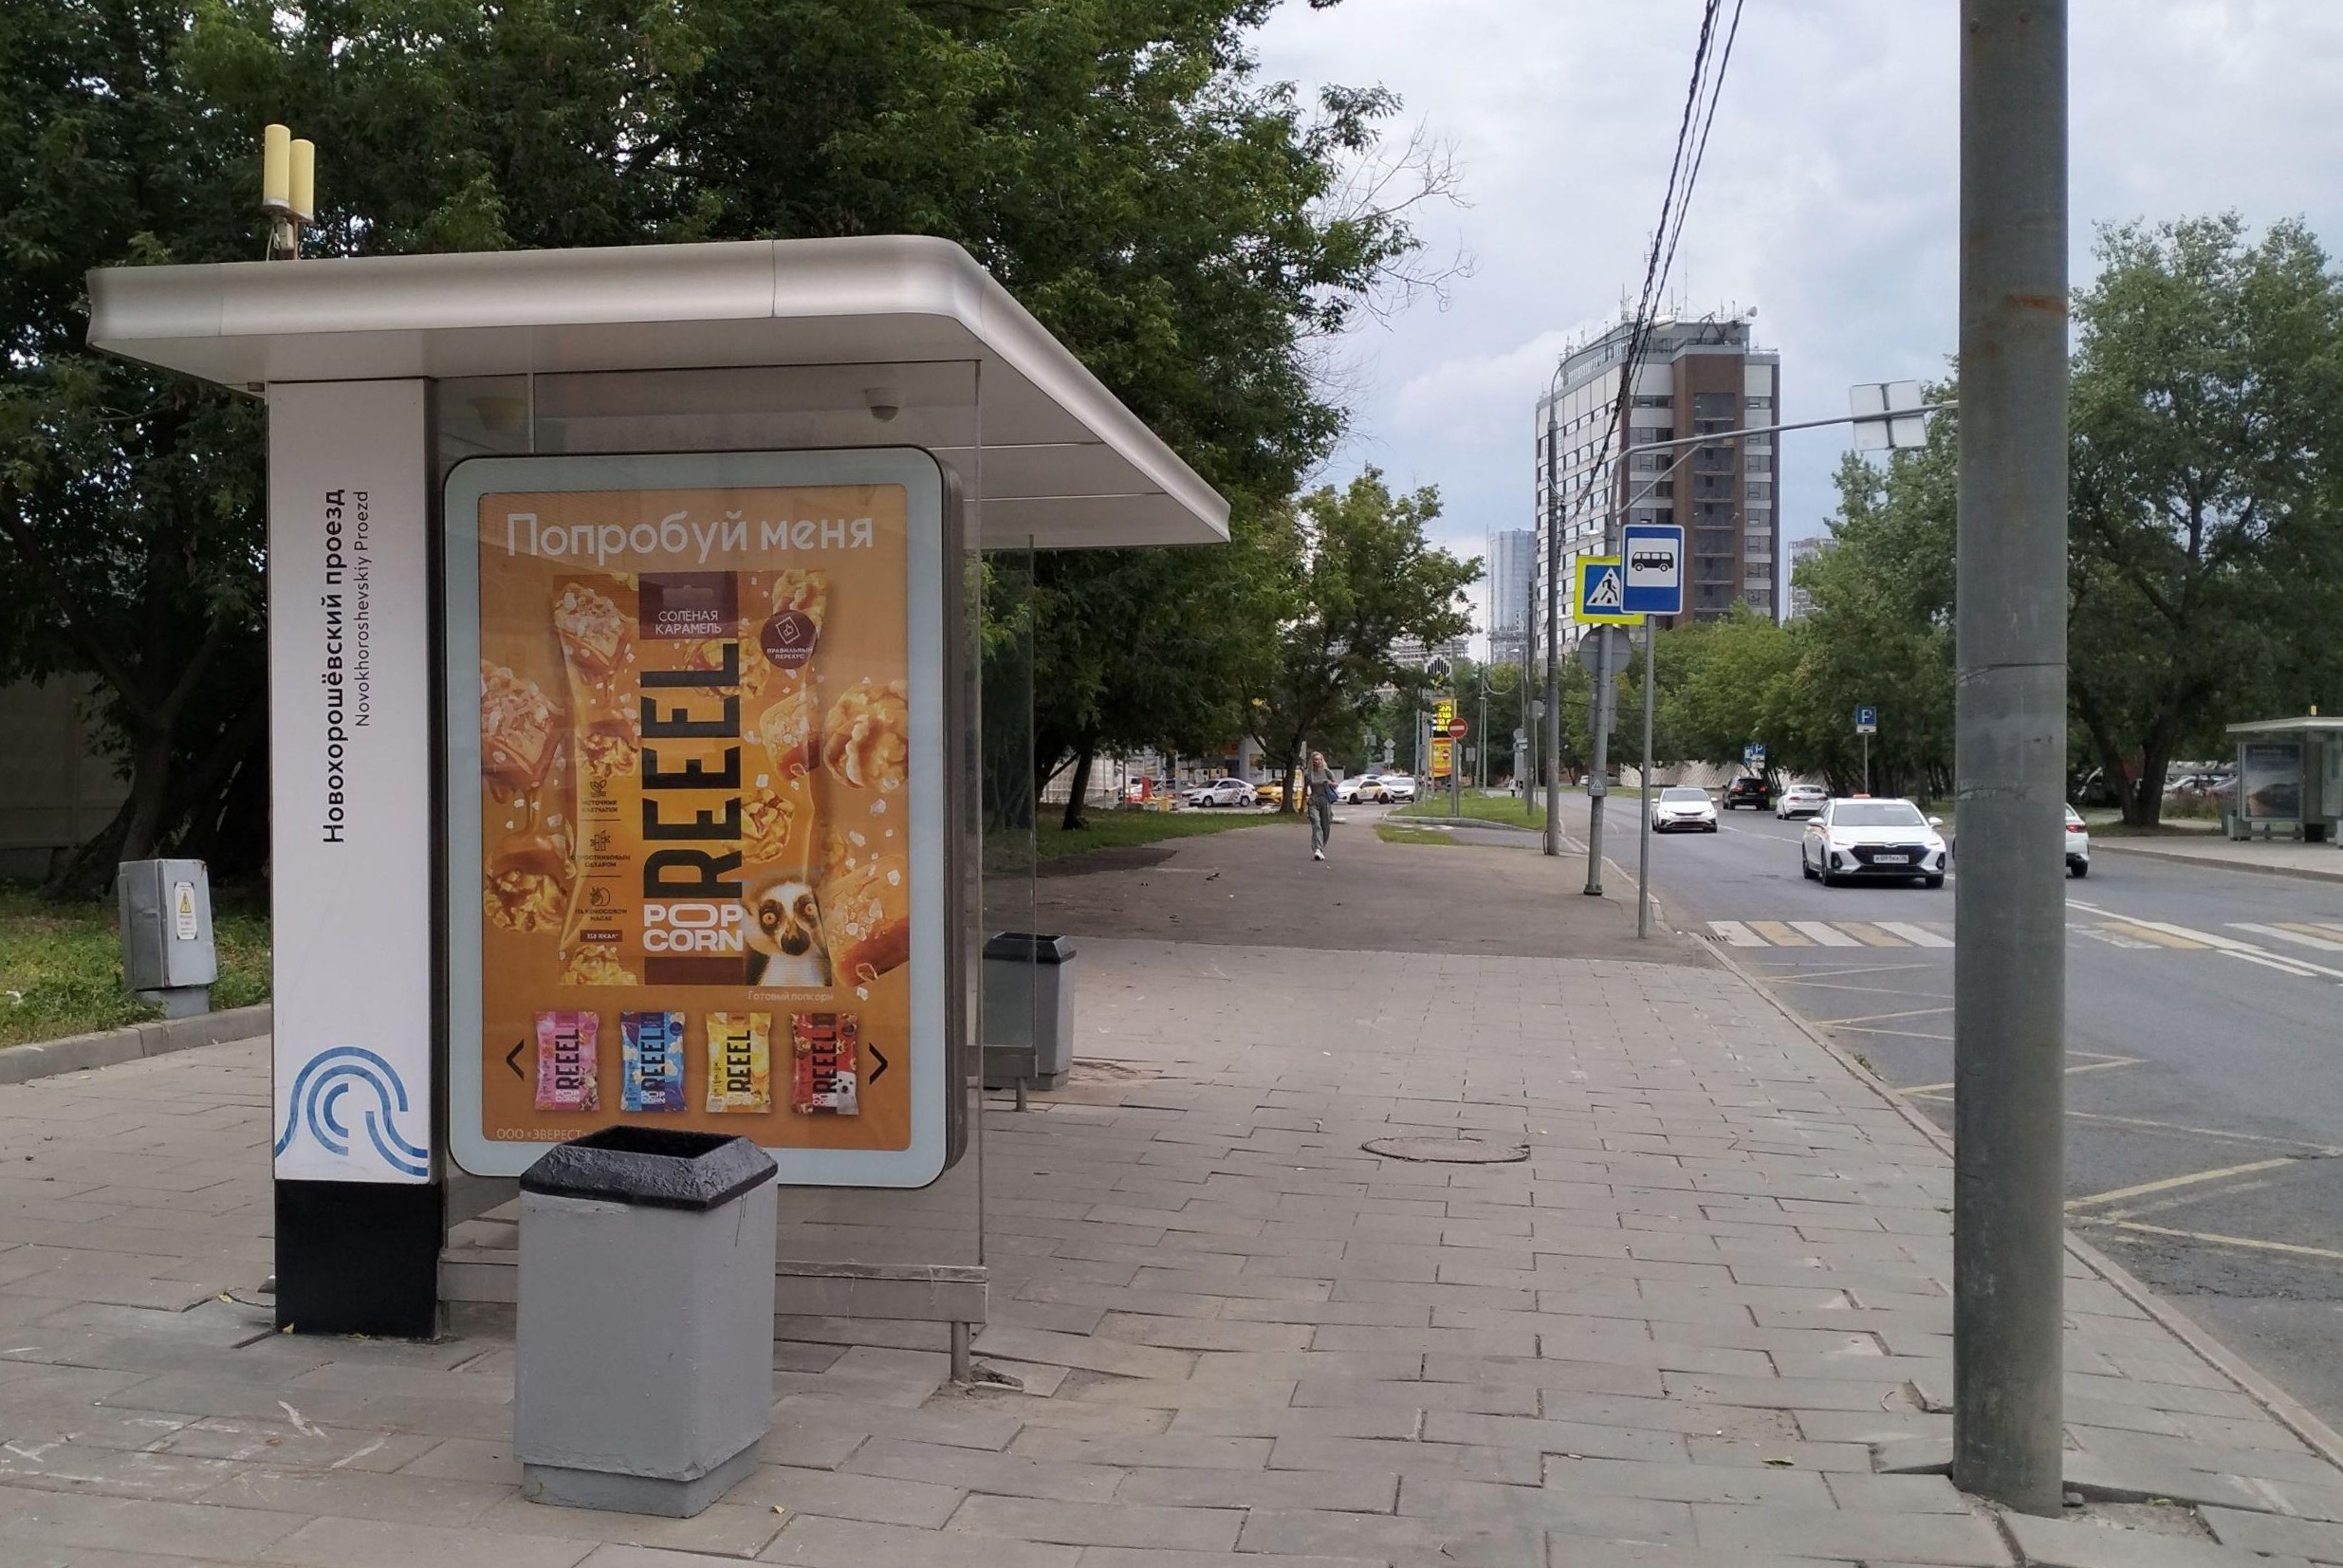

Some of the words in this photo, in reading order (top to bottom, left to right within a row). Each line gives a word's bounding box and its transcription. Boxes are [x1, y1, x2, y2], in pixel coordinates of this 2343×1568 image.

[326, 489, 347, 584] проезд
[353, 491, 369, 550] Proezd
[507, 509, 748, 566] Попробуй
[761, 517, 875, 551] меня
[655, 623, 723, 635] КАРАМЕЛЬ
[658, 608, 718, 622] СОЛЁНАЯ
[353, 556, 372, 727] Novokhoroshevskiy
[321, 595, 349, 842] Новохорошёвский
[639, 643, 744, 899] REEEL
[643, 903, 744, 928] POP
[643, 928, 744, 952] CORN
[747, 990, 789, 1002] Готовый
[790, 992, 834, 1004] попкорн
[496, 1128, 525, 1139] ООО
